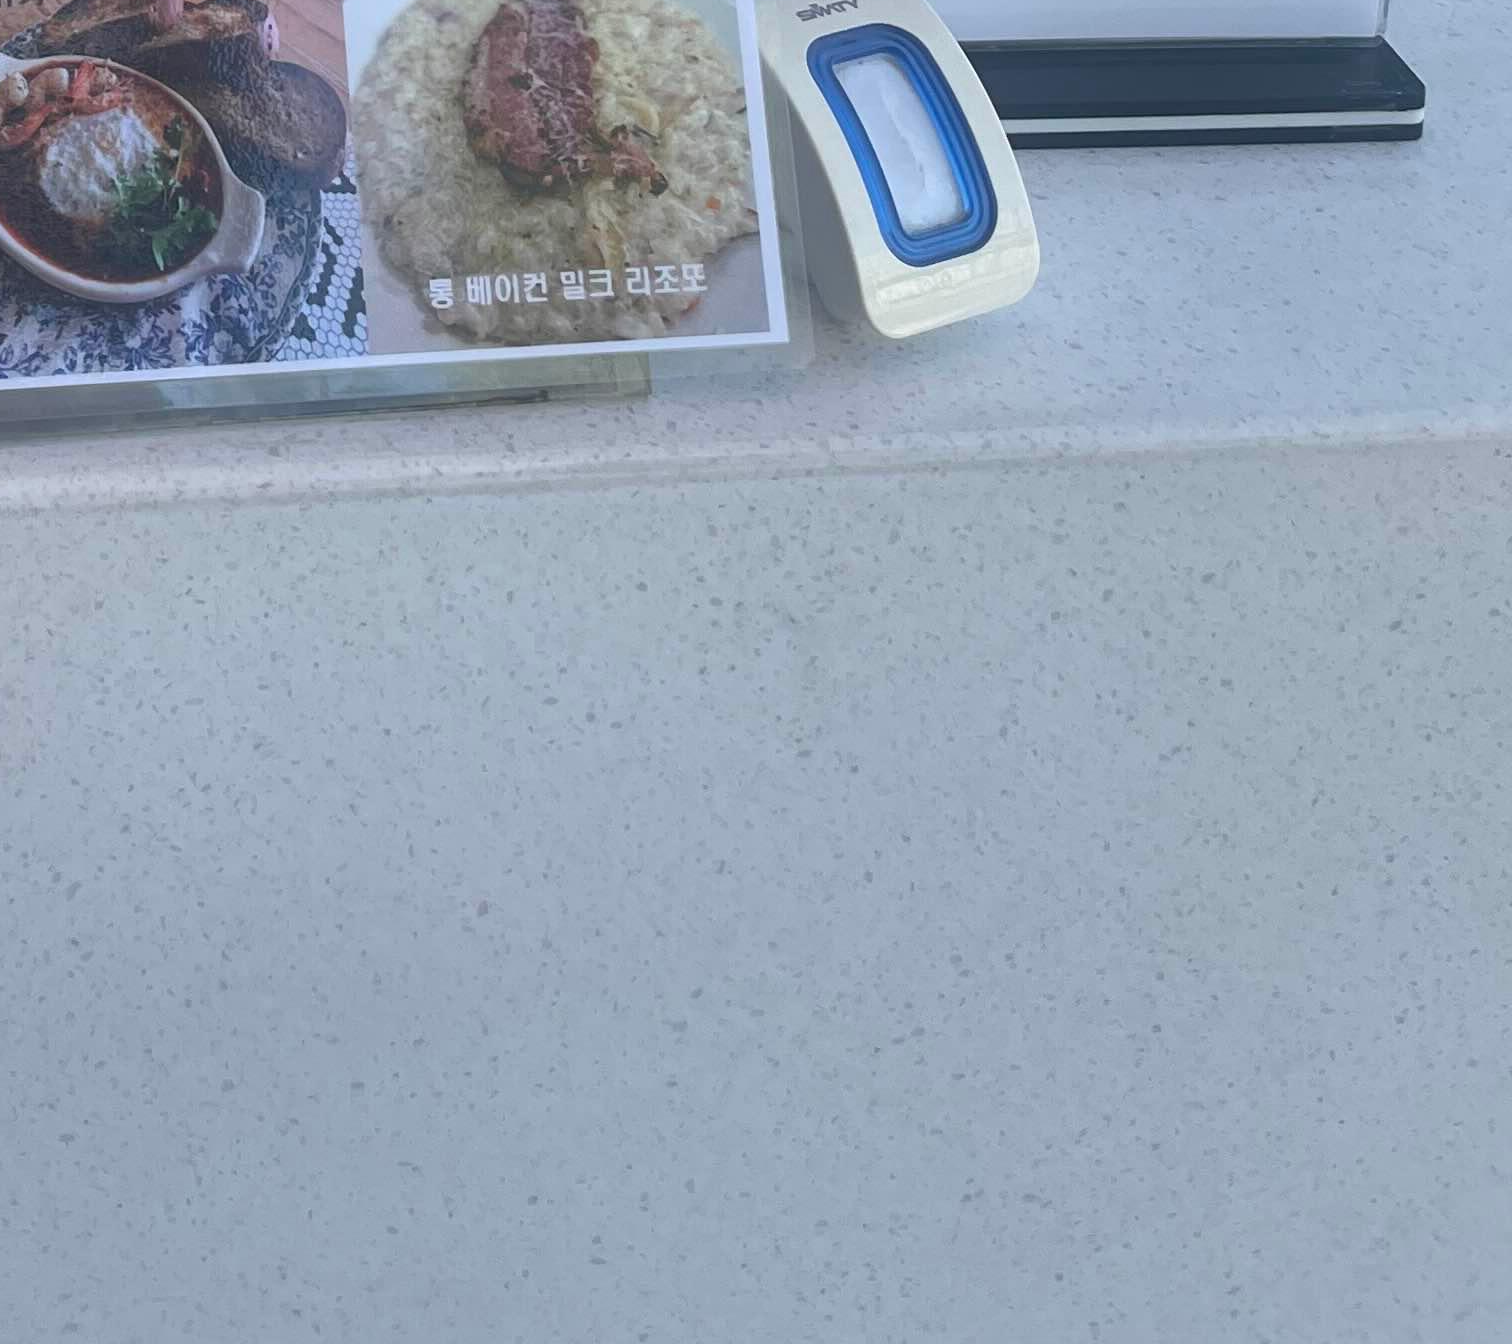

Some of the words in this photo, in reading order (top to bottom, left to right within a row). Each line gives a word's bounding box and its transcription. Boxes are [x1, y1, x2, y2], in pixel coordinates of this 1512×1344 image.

[466, 273, 548, 305] 베이컨
[560, 268, 615, 301] 밀크
[626, 263, 708, 296] 리조또
